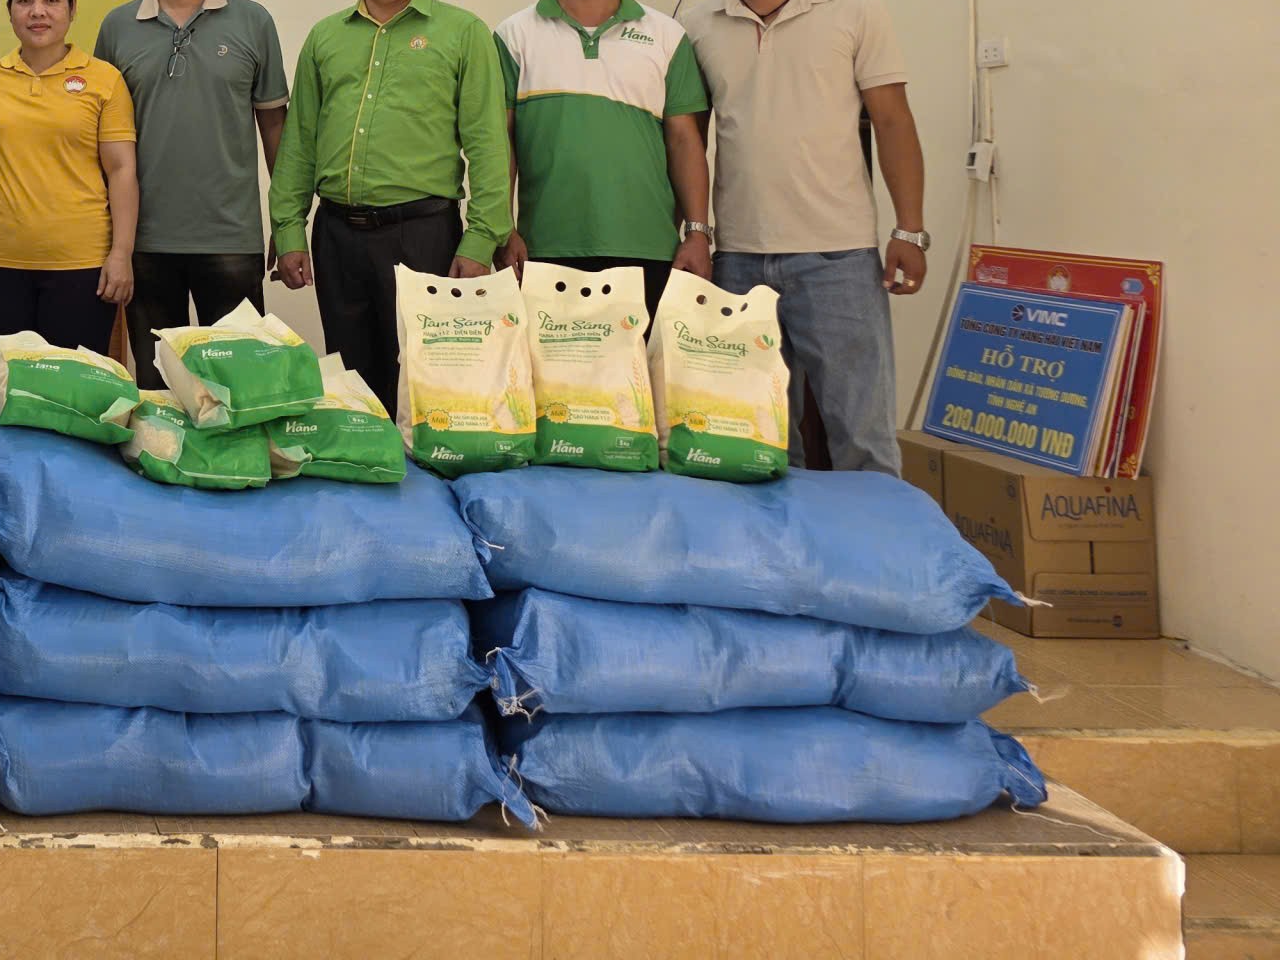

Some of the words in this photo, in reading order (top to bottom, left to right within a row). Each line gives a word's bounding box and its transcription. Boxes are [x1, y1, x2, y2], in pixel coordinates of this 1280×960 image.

[538, 310, 568, 331] Tâm
[571, 320, 614, 337] Sáng
[1026, 308, 1068, 327] VIMC
[673, 320, 703, 347] Tâm
[706, 335, 749, 357] Sáng
[202, 348, 233, 358] Hana
[980, 344, 1015, 368] HỖ
[1020, 355, 1066, 383] TRỢ
[285, 421, 318, 433] Hana
[431, 446, 465, 461] Hana
[550, 439, 585, 454] Hana
[686, 447, 721, 465] Hana
[1041, 489, 1142, 521] AQUAFINA
